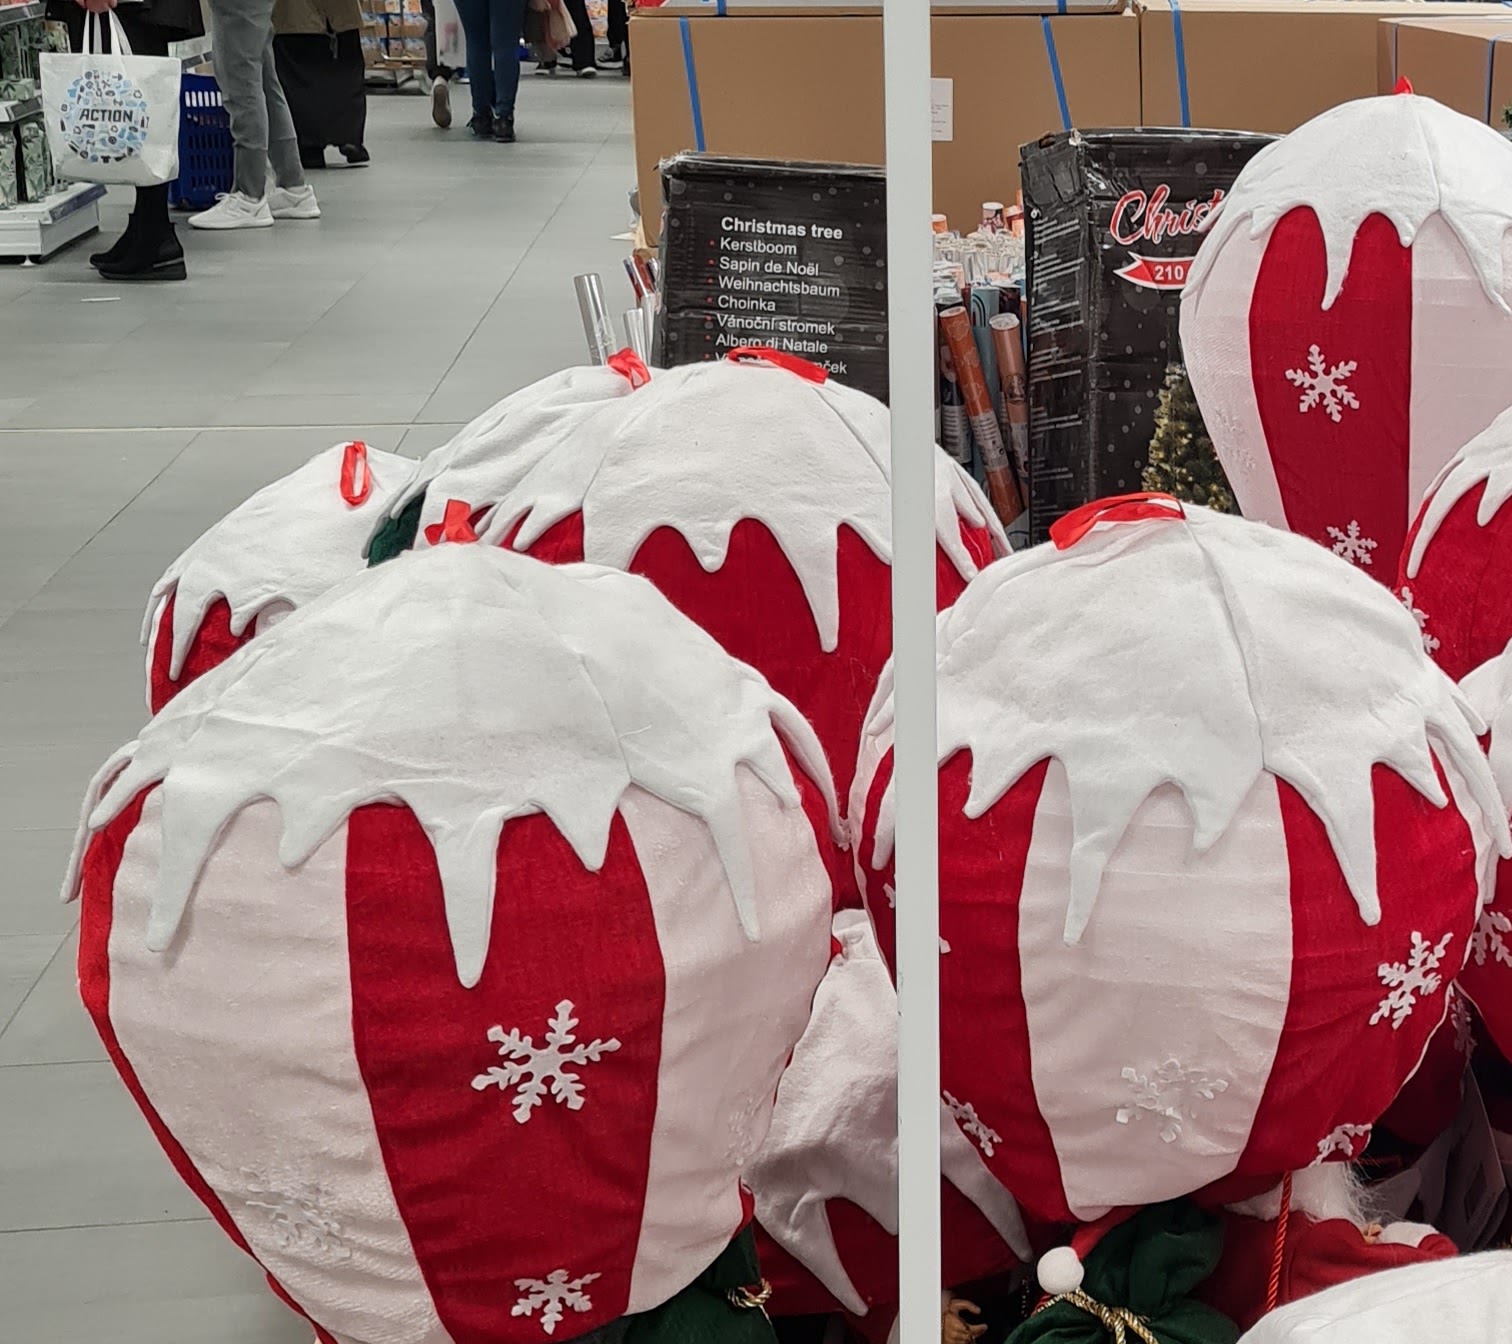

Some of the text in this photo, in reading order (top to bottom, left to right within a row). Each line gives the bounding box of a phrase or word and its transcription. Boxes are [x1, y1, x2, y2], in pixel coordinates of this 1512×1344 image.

[79, 108, 133, 123] ACTION
[721, 216, 844, 240] Christmas tree
[720, 237, 798, 256] Kerstboom
[719, 256, 820, 277] Sapin de Noël
[1154, 265, 1185, 281] 210
[718, 275, 841, 298] Weihnachtsbaum
[717, 294, 777, 312] Choinka
[716, 312, 836, 335] Vánoční stromek
[715, 333, 829, 354] Albero di Natale
